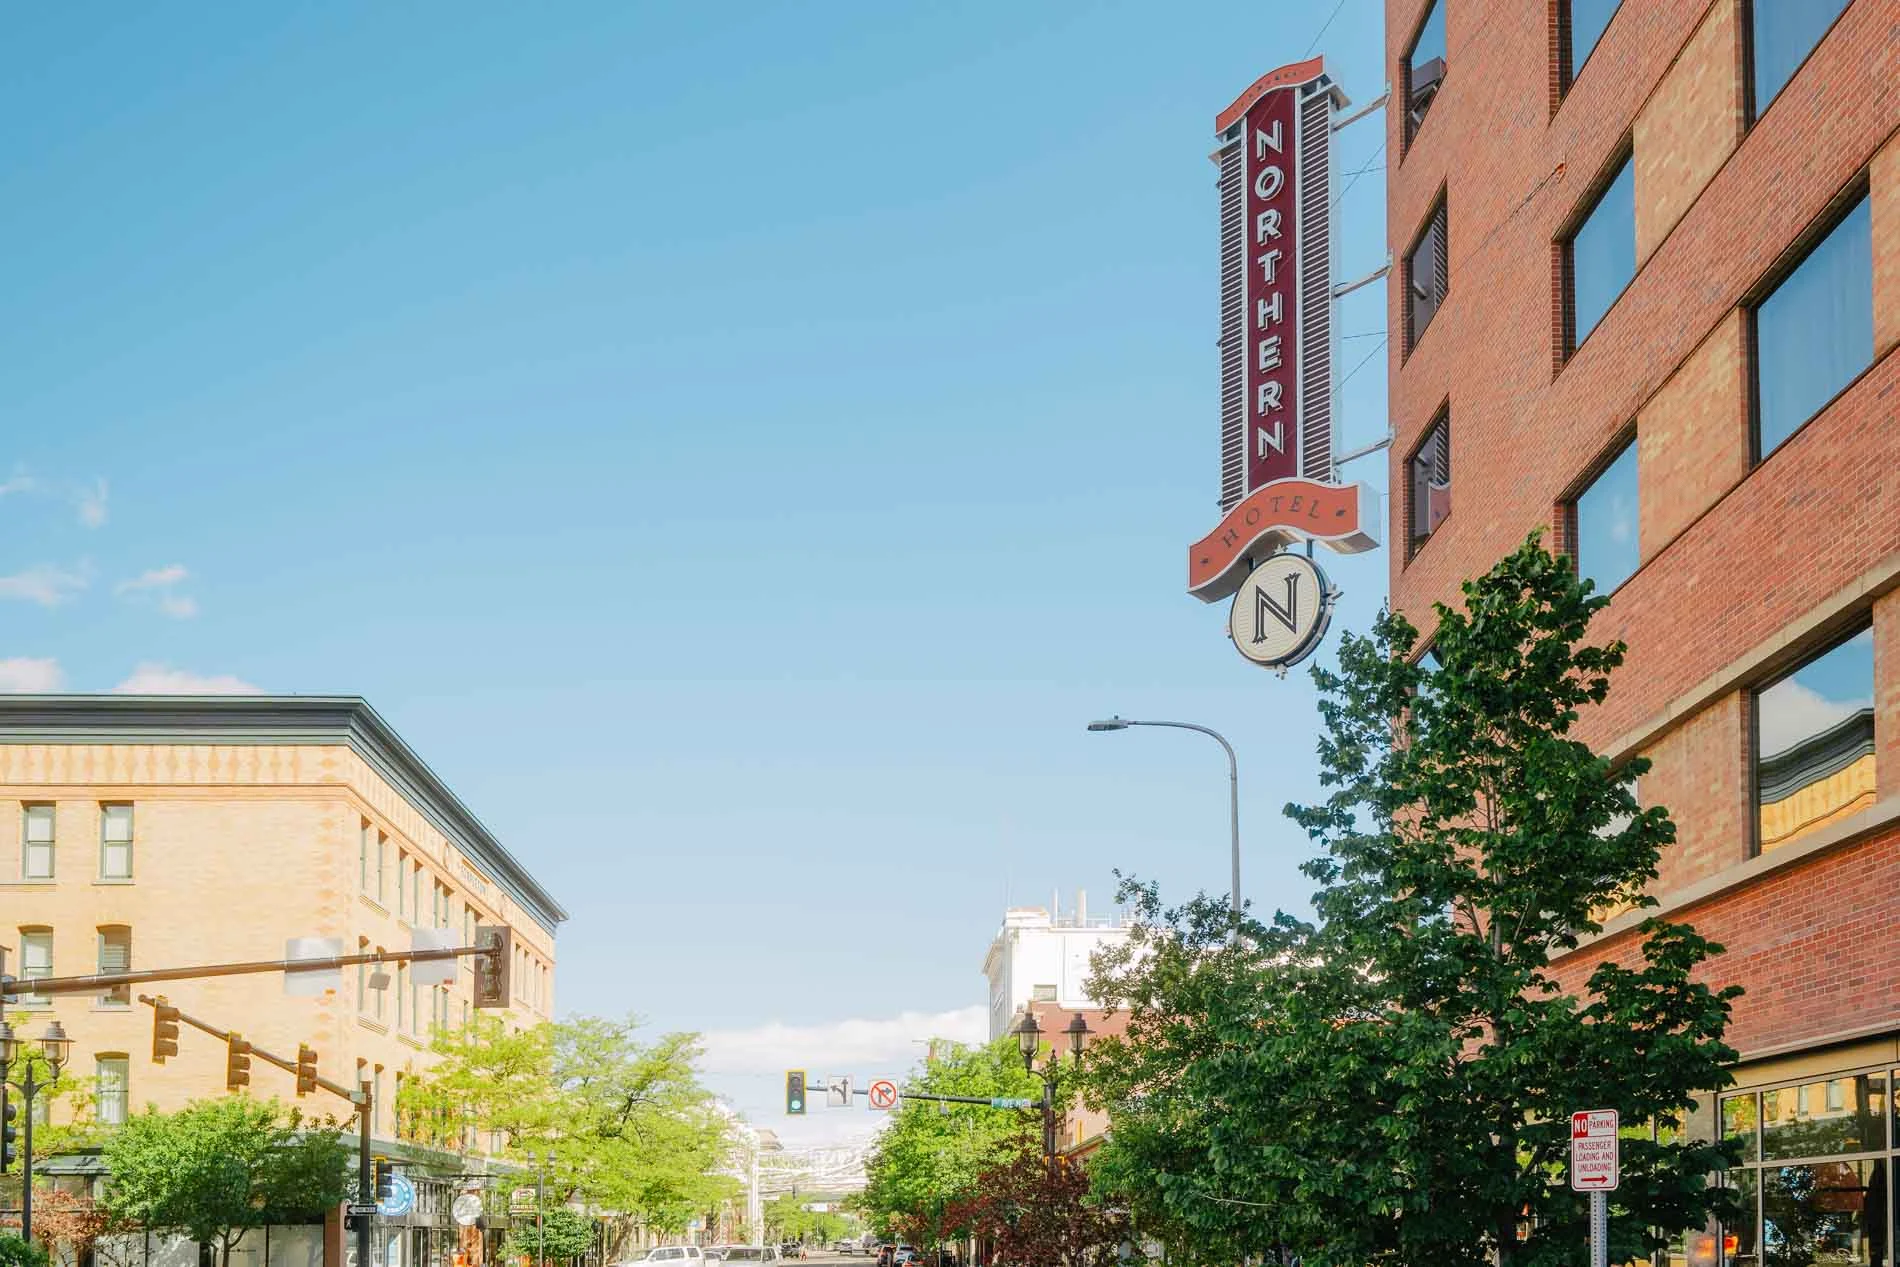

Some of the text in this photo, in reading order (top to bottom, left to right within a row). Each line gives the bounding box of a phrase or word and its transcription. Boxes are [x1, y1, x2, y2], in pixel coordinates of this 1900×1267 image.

[1255, 119, 1285, 460] NORTHERN
[1222, 495, 1322, 548] HOTEL
[1252, 571, 1302, 645] N
[1574, 1119, 1614, 1133] NO PARKING
[1578, 1141, 1612, 1151] PASSENGER
[1576, 1151, 1614, 1162] LOADING AND
[1577, 1162, 1612, 1172] UNLOADING
